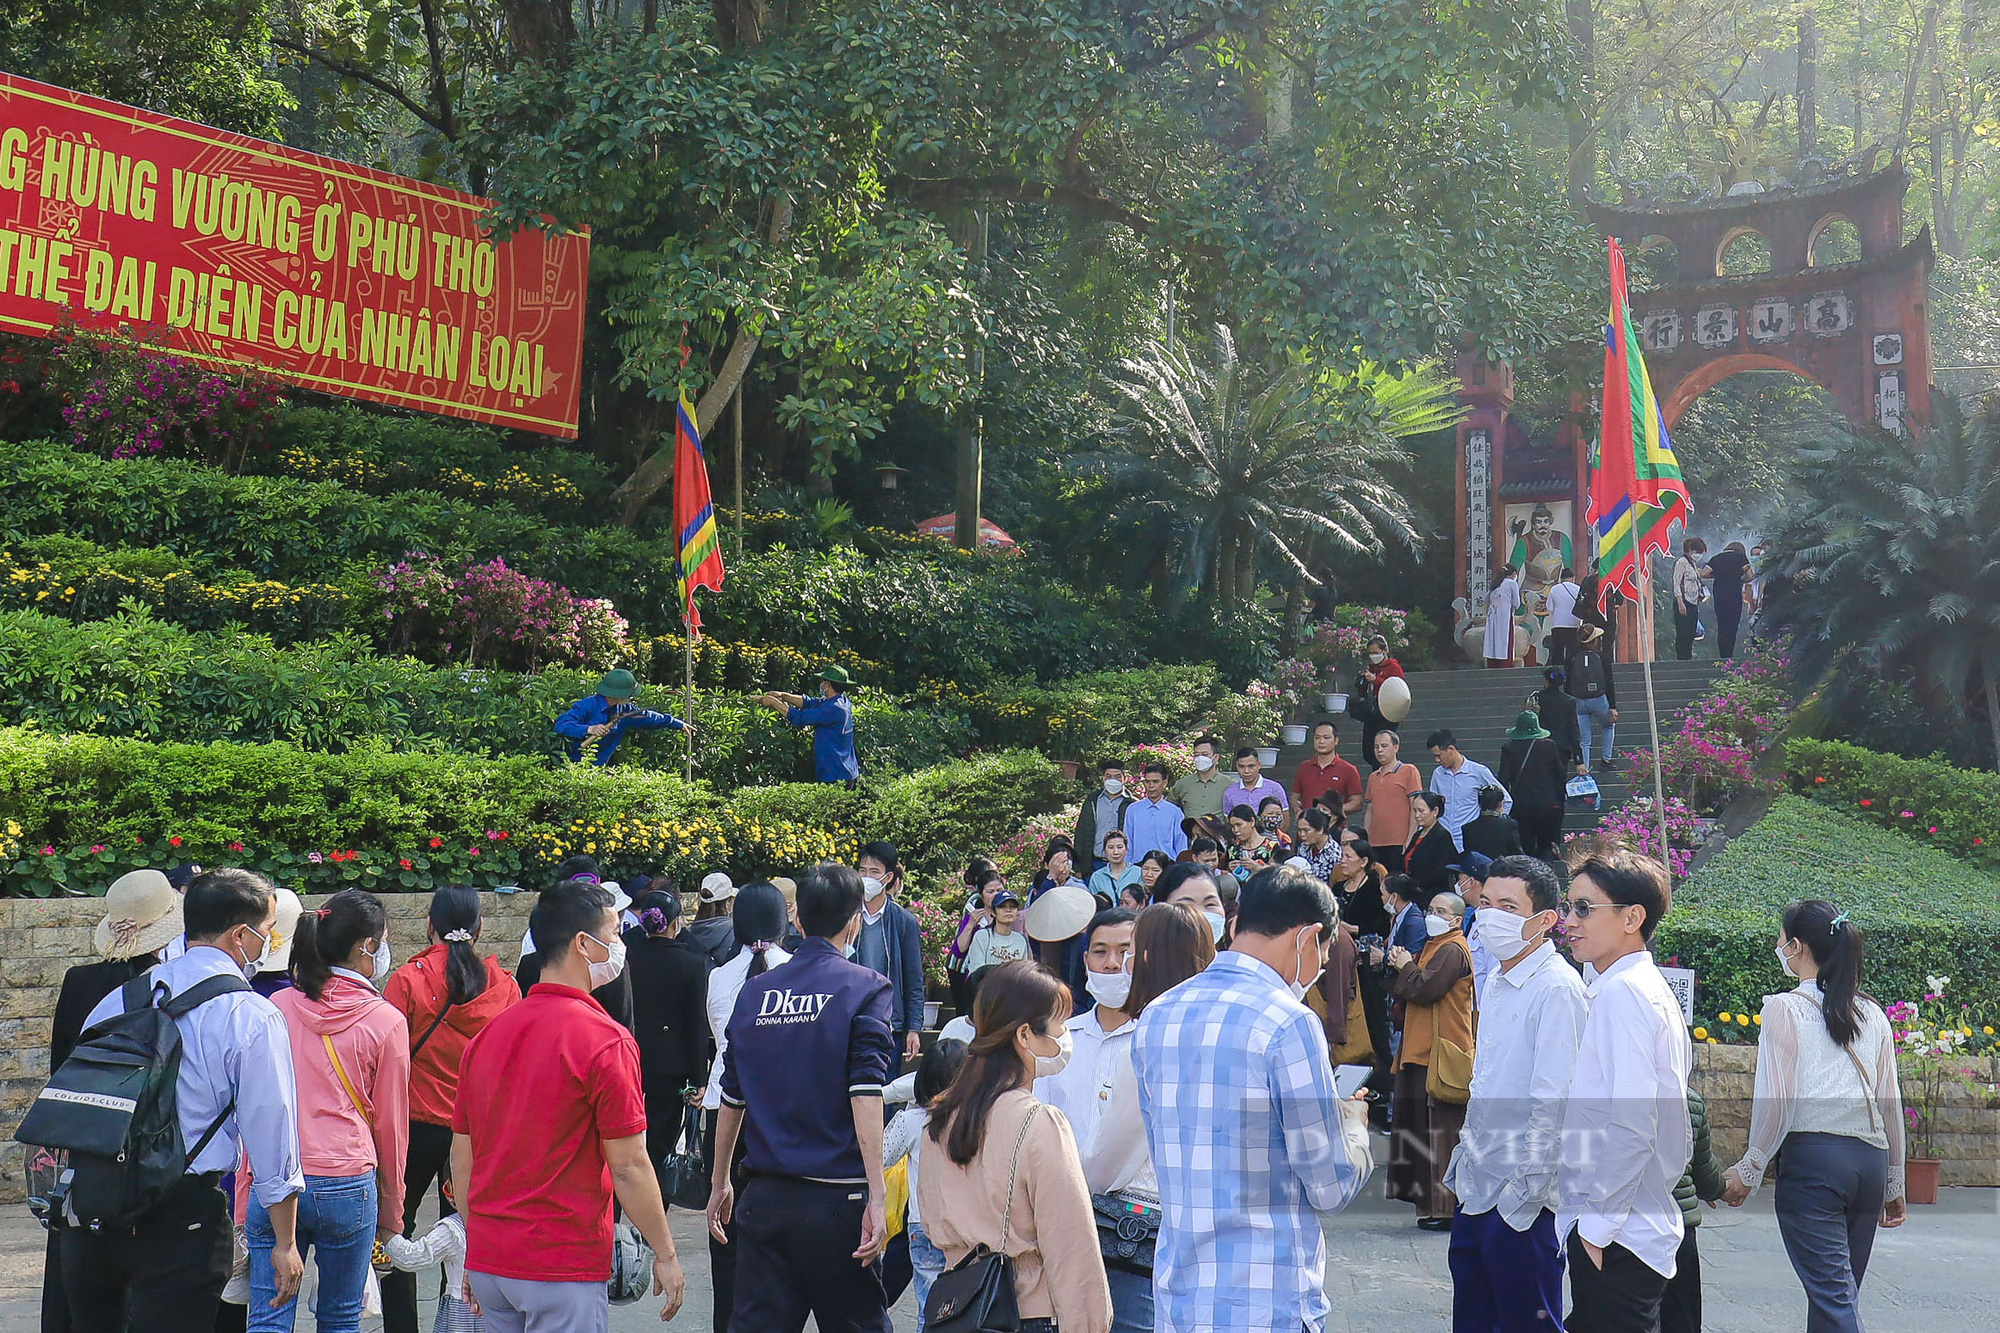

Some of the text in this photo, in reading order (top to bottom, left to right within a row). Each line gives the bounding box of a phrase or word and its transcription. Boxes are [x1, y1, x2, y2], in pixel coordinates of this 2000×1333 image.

[40, 131, 158, 223] HÙNG
[172, 168, 302, 255] VƯƠNG
[312, 180, 342, 262] Ở
[348, 211, 421, 281] PHÚ
[432, 231, 495, 310] THỌ
[0, 218, 544, 408] THỂ ĐẠI DIỆN CỦA NHÂN LOẠI
[755, 1014, 810, 1026] DONNA KARAN
[757, 988, 834, 1022] Dkny
